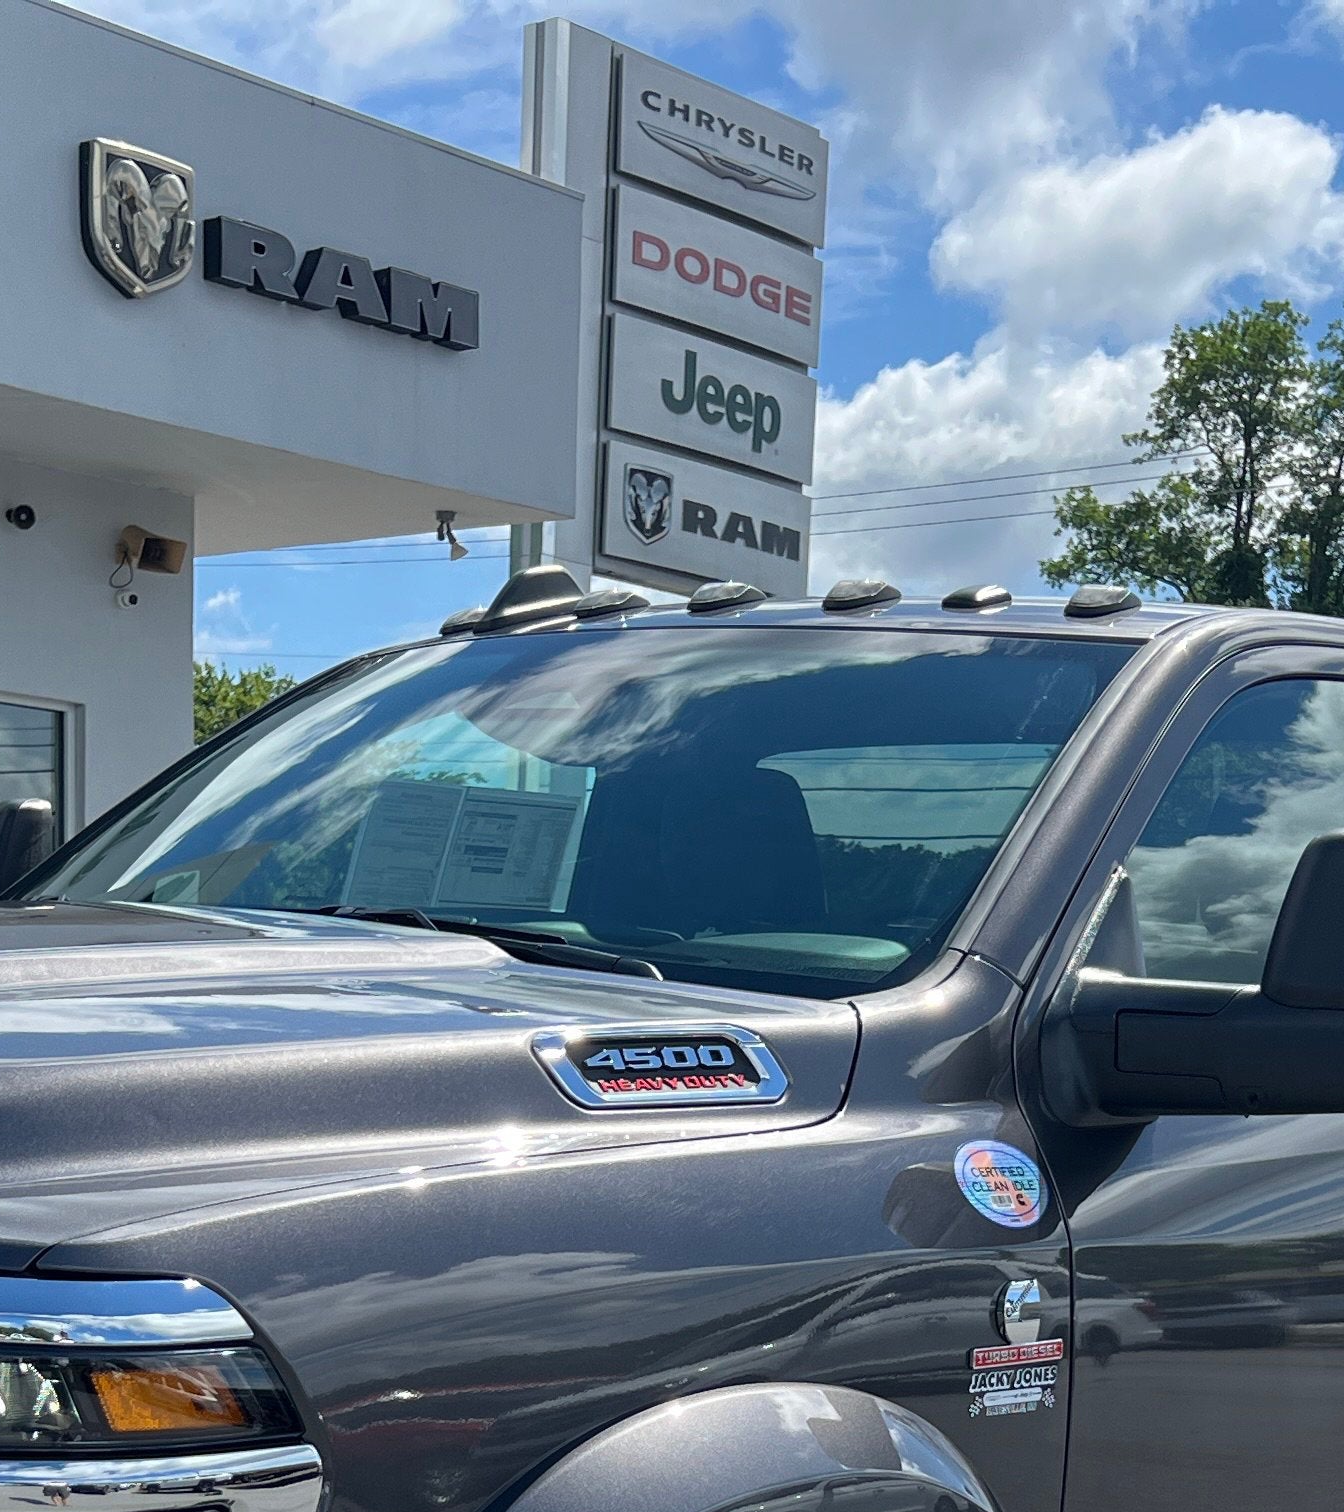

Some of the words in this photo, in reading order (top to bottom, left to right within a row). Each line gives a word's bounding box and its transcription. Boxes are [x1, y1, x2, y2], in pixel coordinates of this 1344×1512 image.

[641, 90, 814, 177] CHRYSLER
[203, 215, 479, 351] RAM
[632, 230, 812, 326] DODGE
[661, 350, 781, 453] Jeep
[682, 499, 801, 562] RAM
[583, 1044, 735, 1071] 4500
[598, 1076, 678, 1095] HEAVY
[683, 1074, 746, 1090] DUTY
[970, 1166, 1025, 1178] CERTIFIED
[971, 1180, 1010, 1192] CLEAN
[1011, 1179, 1037, 1191] IDLE
[1019, 1344, 1061, 1360] DIESEL
[969, 1368, 1014, 1394] JACKY
[1013, 1365, 1057, 1388] JONES
